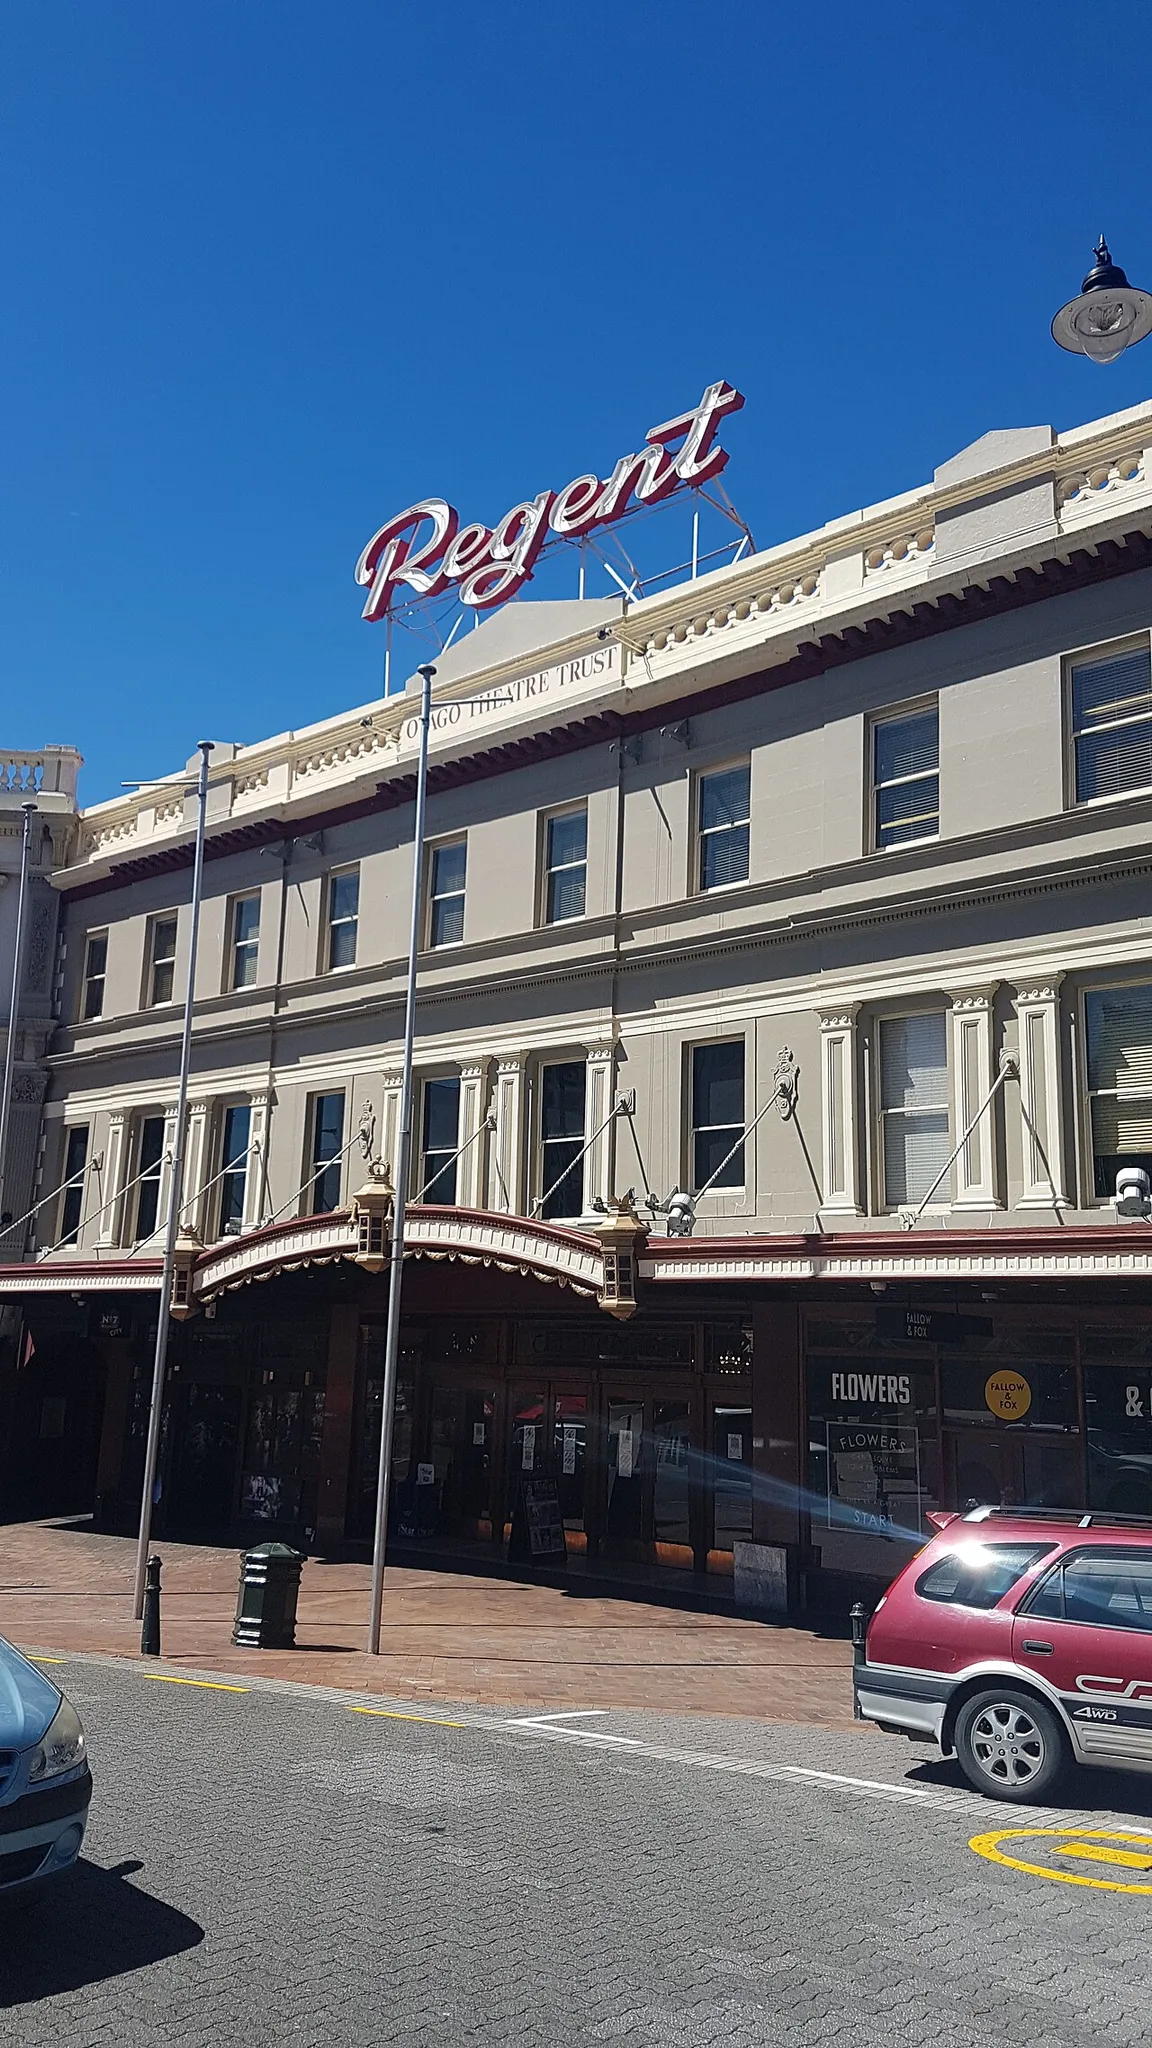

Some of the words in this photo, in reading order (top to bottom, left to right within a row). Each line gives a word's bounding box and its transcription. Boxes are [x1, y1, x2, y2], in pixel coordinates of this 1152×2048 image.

[354, 379, 746, 622] Regent
[406, 703, 461, 739] OAGO
[469, 671, 550, 718] THEATRE
[557, 646, 618, 686] TRUST
[905, 1312, 932, 1325] FALLOW
[906, 1326, 913, 1336] &
[914, 1326, 927, 1338] FOX
[831, 1373, 911, 1404] FLOWERS
[990, 1382, 1025, 1392] FALLOW
[1004, 1392, 1011, 1400] &
[1125, 1385, 1144, 1417] &
[999, 1400, 1018, 1410] FOX
[839, 1433, 907, 1453] FLOWERS
[853, 1510, 895, 1528] START
[1073, 1706, 1117, 1721] 4WD
